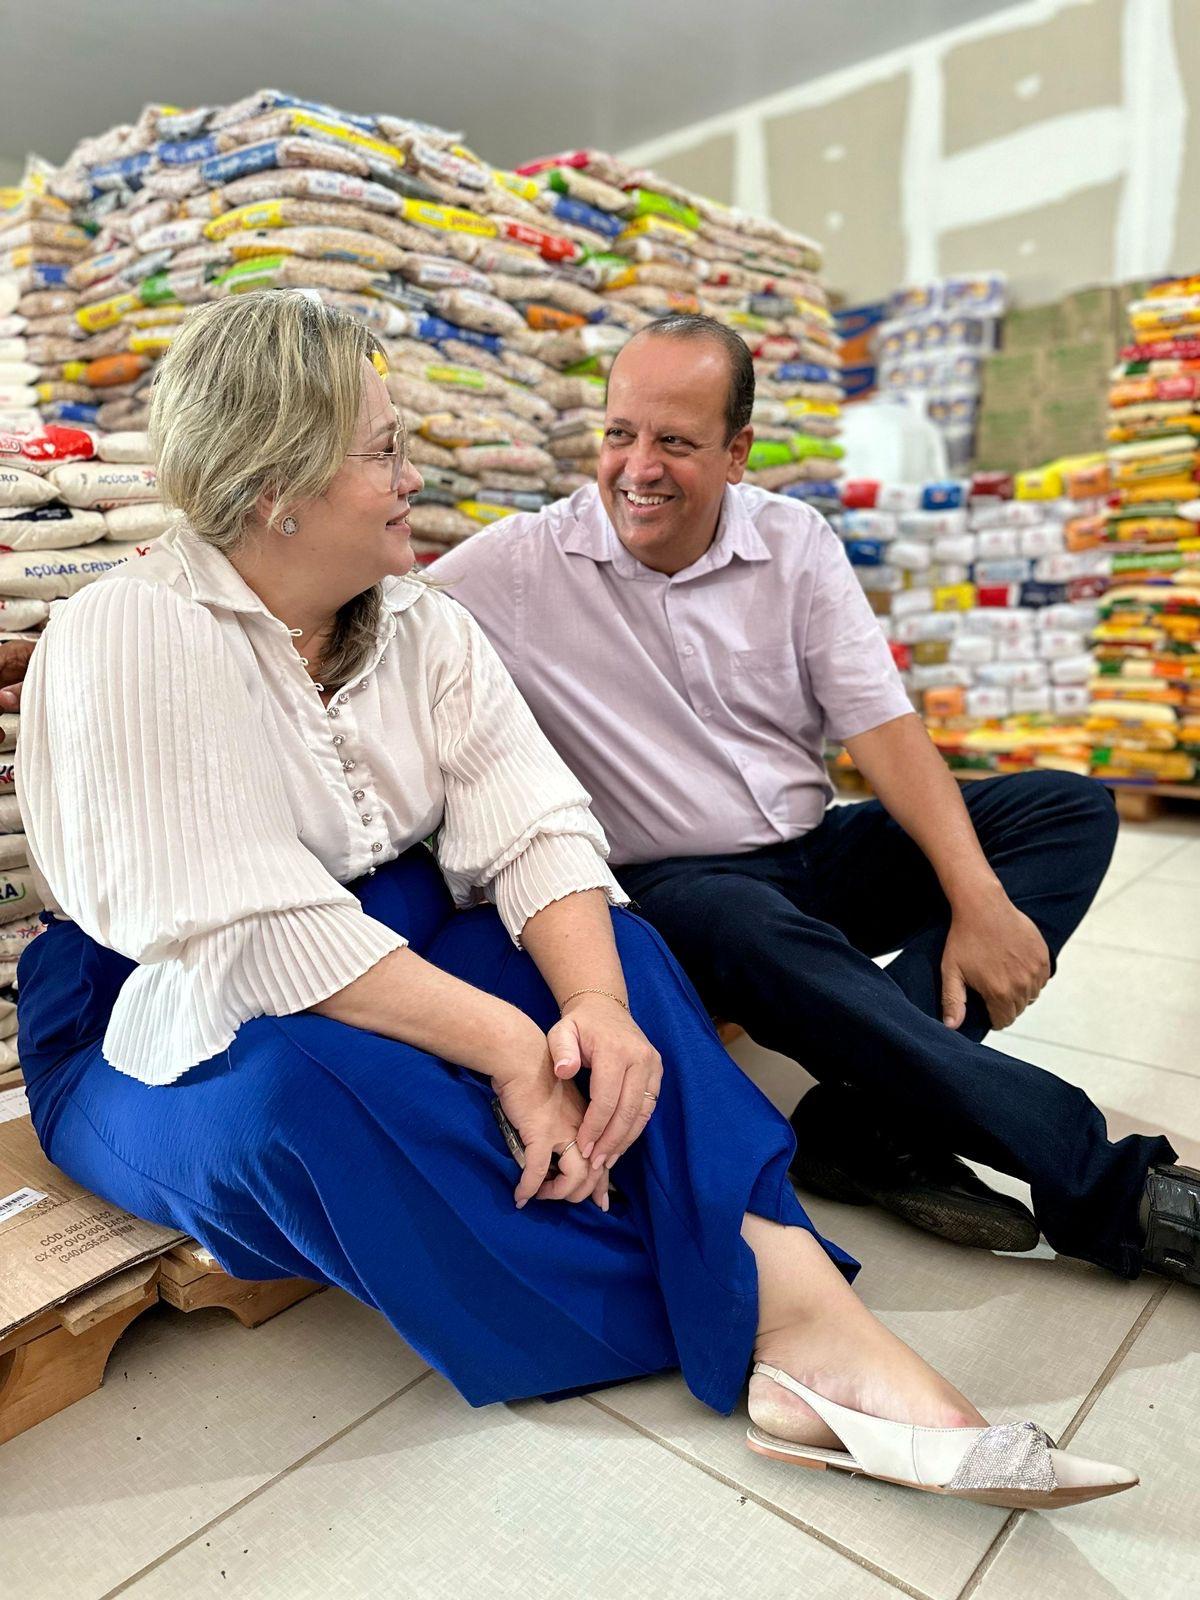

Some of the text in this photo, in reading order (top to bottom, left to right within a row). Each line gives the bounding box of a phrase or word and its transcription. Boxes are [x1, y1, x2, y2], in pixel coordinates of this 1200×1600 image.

[0, 473, 19, 482] RO
[24, 557, 128, 579] AÇÚCAR CRIST
[34, 1251, 51, 1262] CX
[49, 1244, 63, 1254] PP
[64, 1233, 87, 1247] OVO
[85, 1224, 105, 1237] 80G
[40, 1232, 67, 1247] CÓD.
